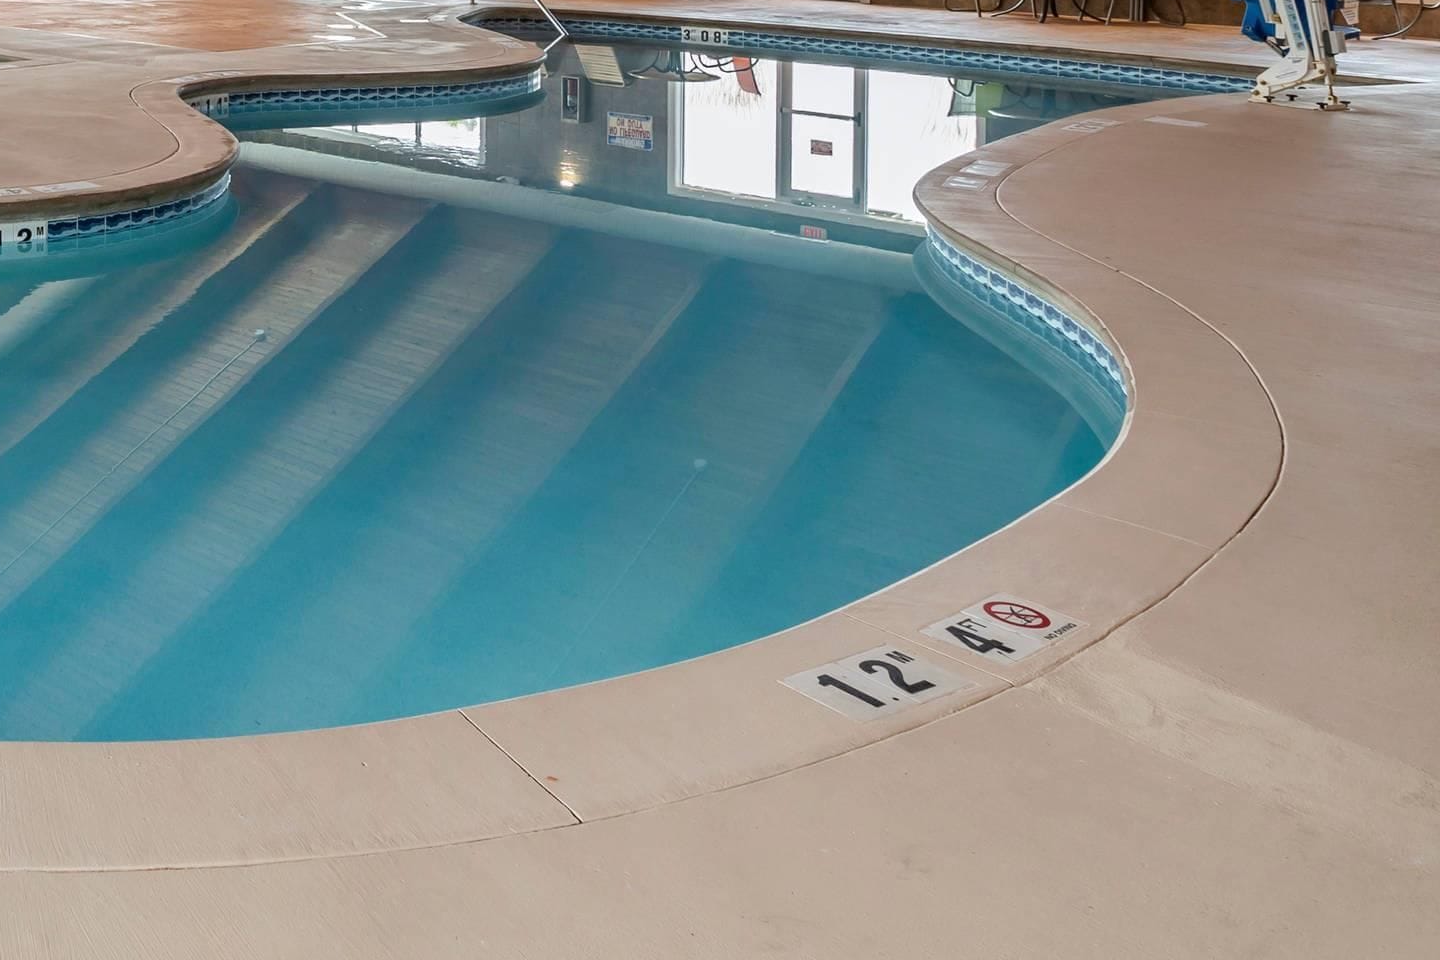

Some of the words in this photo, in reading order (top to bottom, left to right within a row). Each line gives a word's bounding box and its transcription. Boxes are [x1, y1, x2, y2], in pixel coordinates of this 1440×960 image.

[683, 30, 690, 40] 3
[36, 226, 44, 235] M
[957, 618, 987, 632] FT
[1053, 623, 1077, 635] DIVING
[945, 625, 1016, 653] 4
[817, 660, 936, 708] 1.2
[885, 650, 915, 664] M
